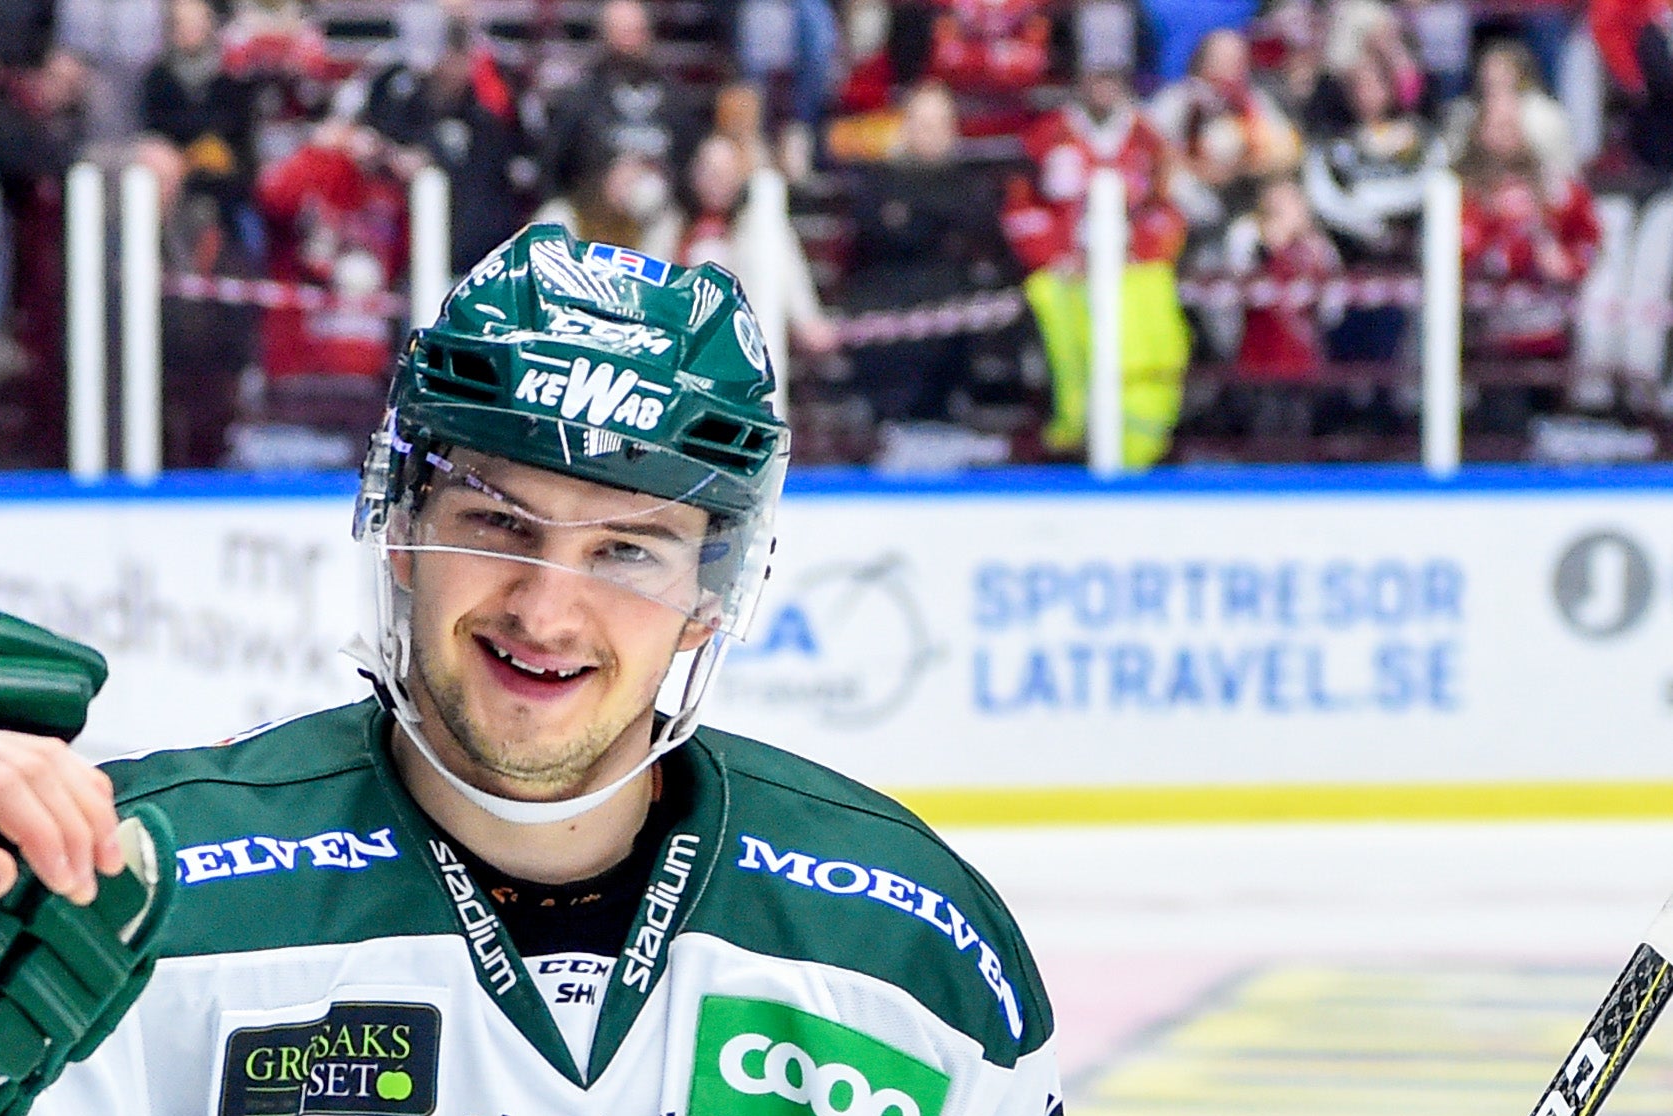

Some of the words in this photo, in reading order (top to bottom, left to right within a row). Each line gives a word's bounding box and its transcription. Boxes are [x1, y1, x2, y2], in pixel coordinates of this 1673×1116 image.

[548, 310, 673, 356] CCM
[970, 558, 1467, 630] SPORTRESOR
[176, 828, 398, 885] ELVEN
[429, 838, 518, 997] stadium
[622, 833, 701, 993] stadium
[538, 958, 610, 978] CCM
[245, 1024, 411, 1082] GRSAKS
[302, 1062, 379, 1098] SET
